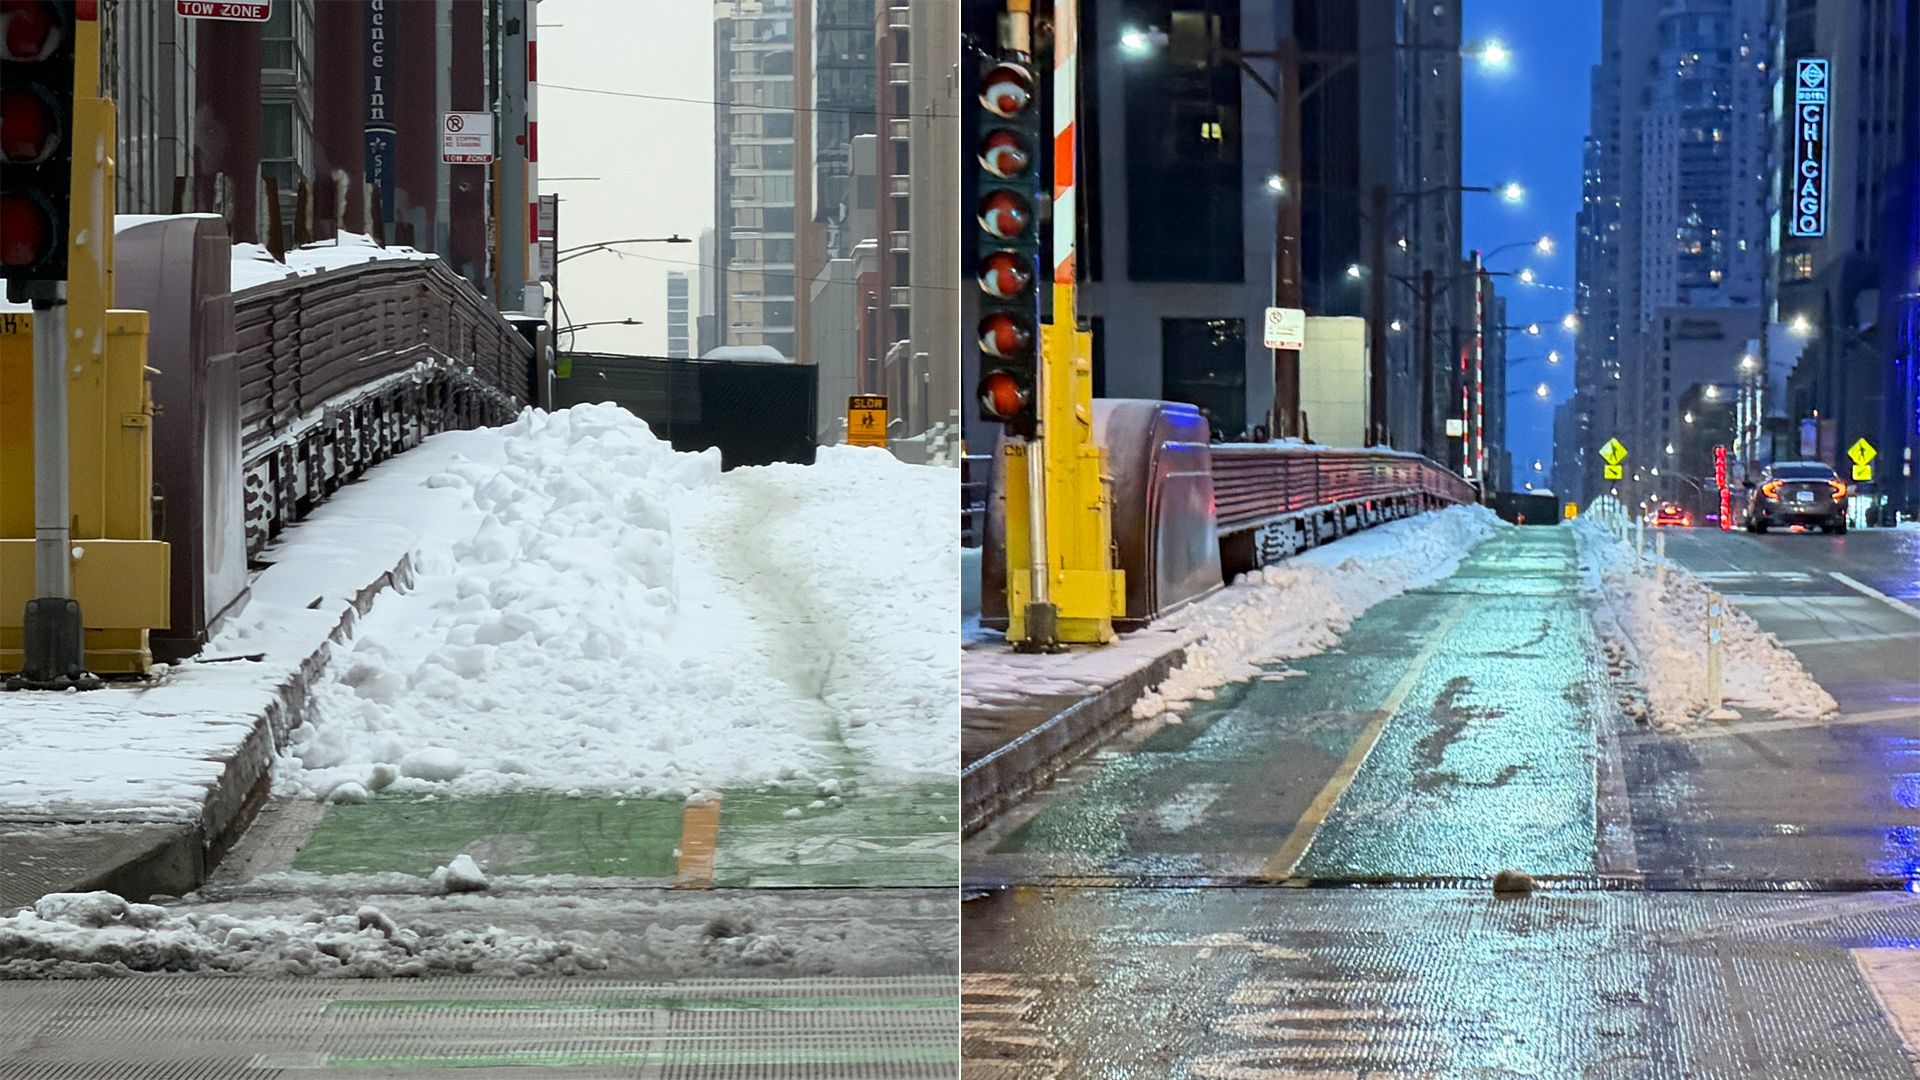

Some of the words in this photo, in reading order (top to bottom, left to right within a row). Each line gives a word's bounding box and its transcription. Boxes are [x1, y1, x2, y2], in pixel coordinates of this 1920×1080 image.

[183, 2, 214, 15] TOW
[221, 4, 262, 18] ZONE
[371, 75, 385, 120] Inn
[1800, 105, 1820, 232] CHICAGO
[853, 398, 883, 409] SLOW
